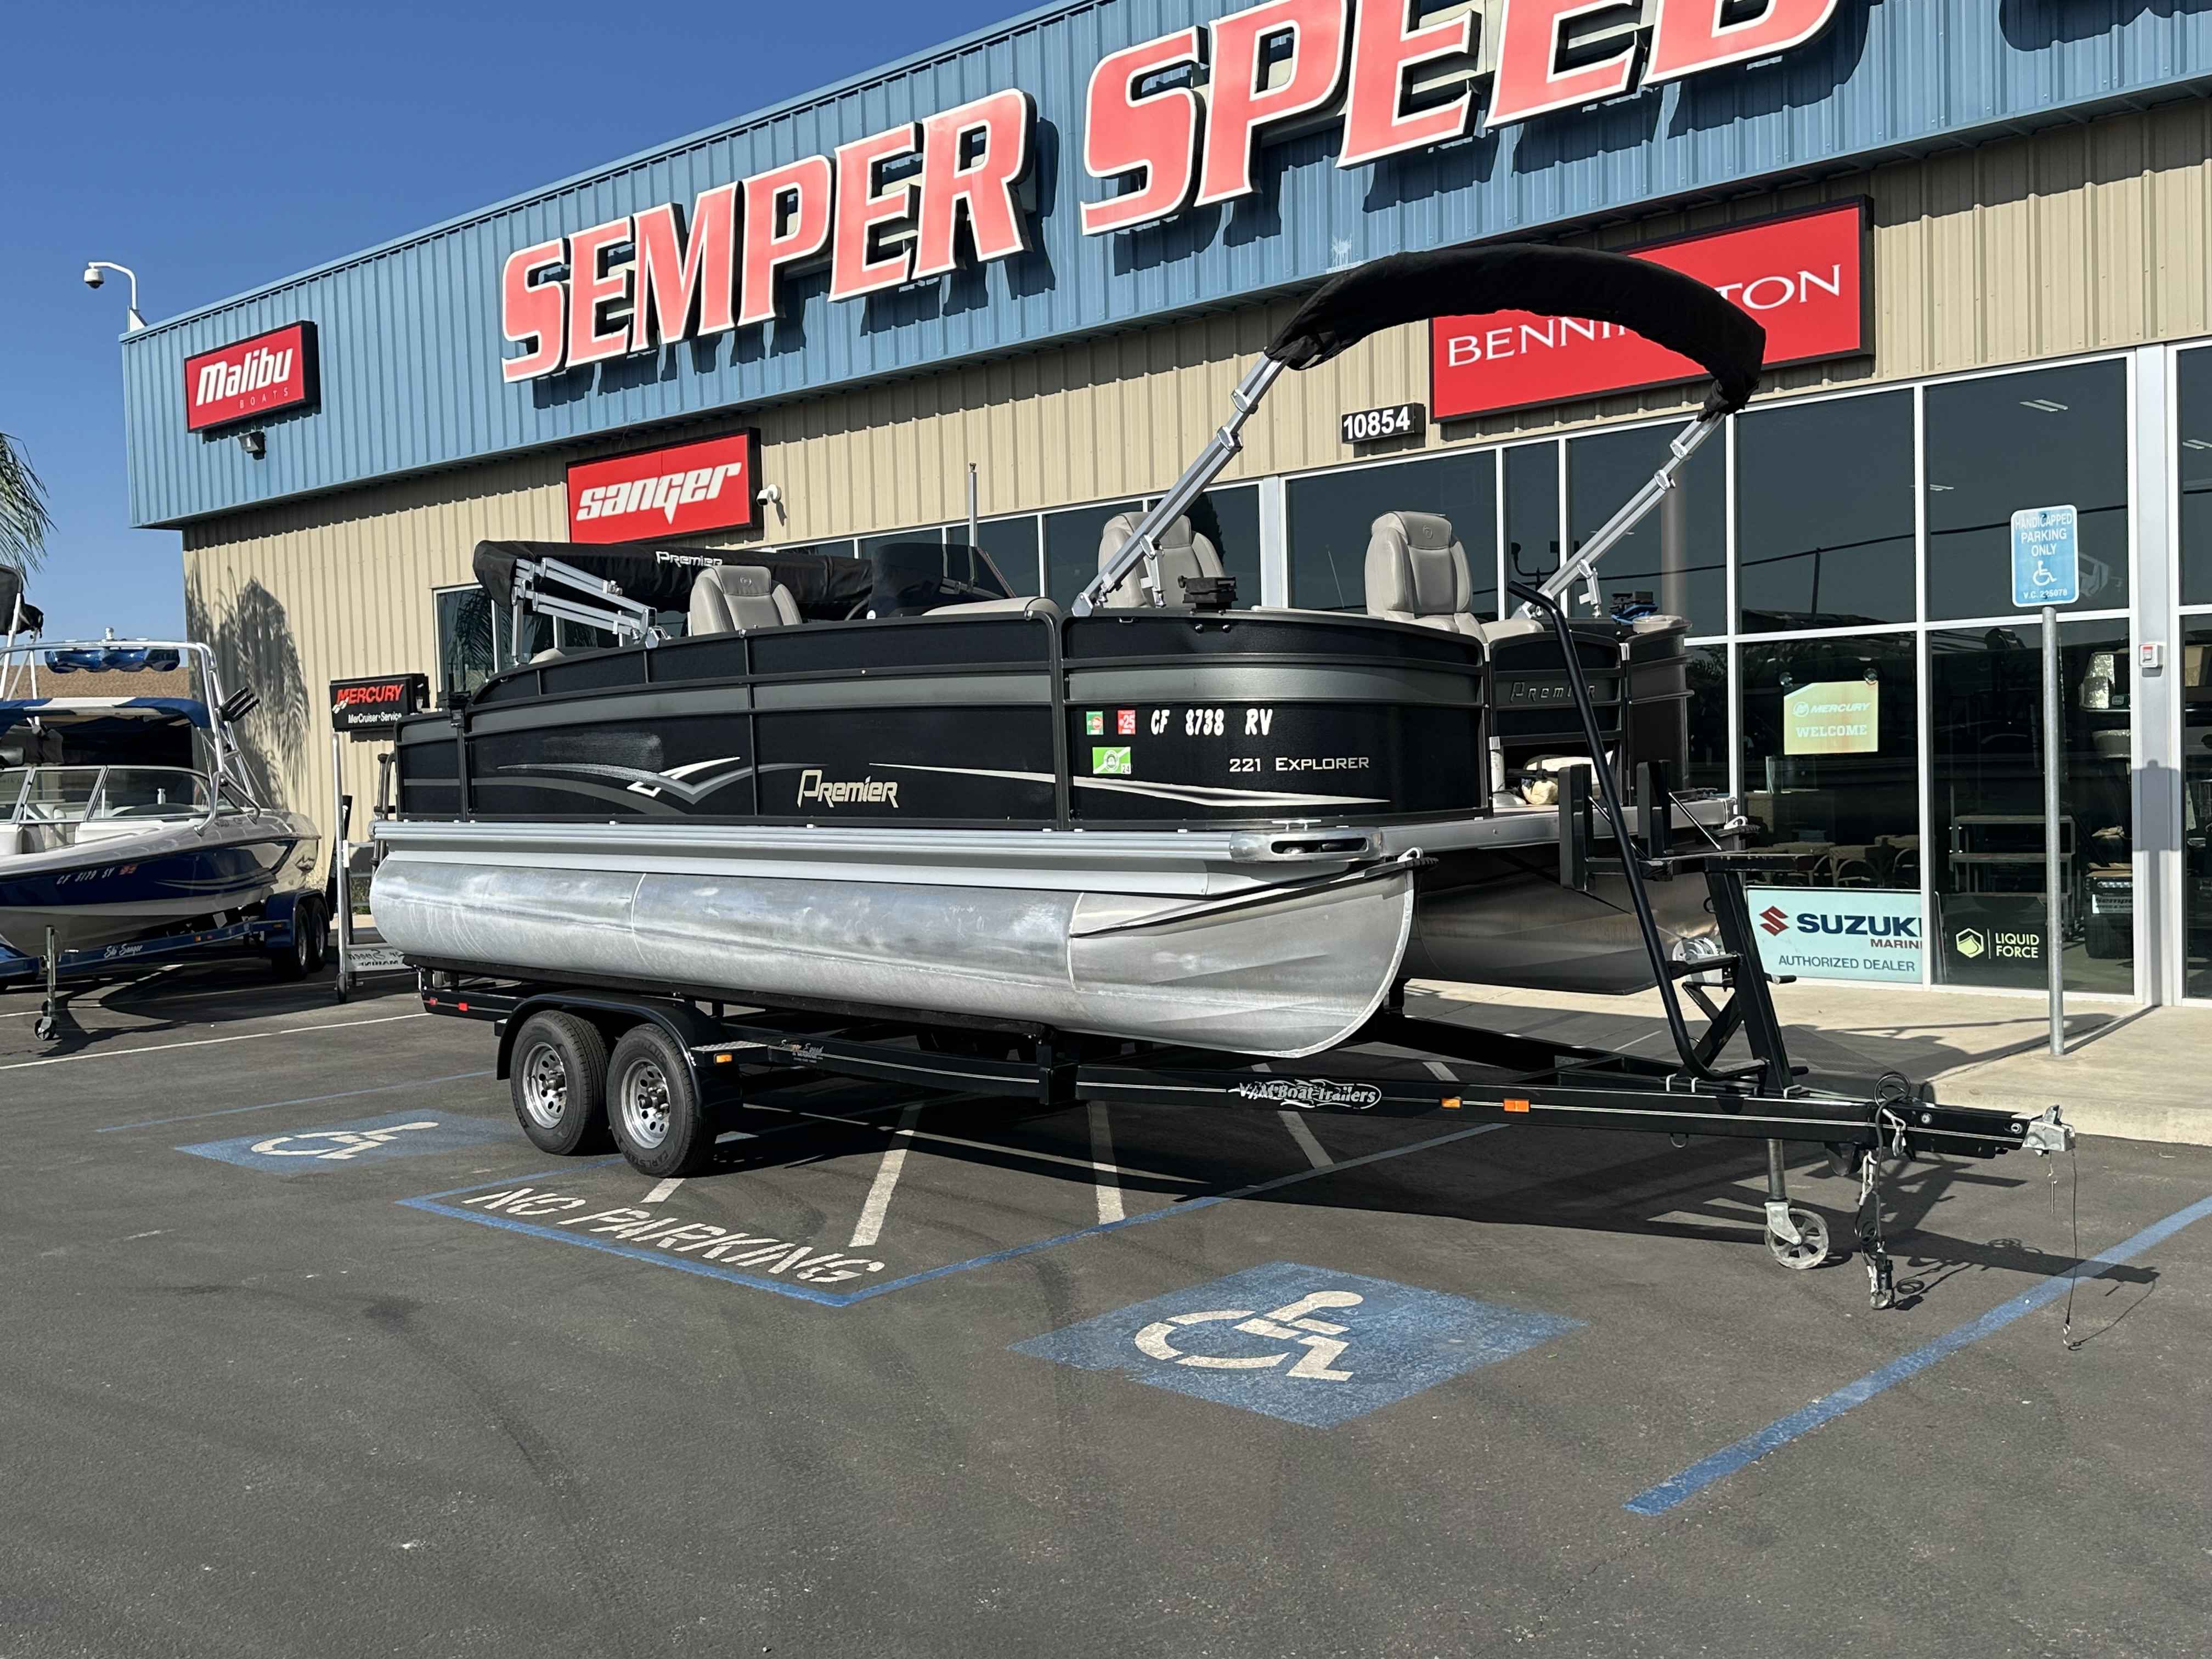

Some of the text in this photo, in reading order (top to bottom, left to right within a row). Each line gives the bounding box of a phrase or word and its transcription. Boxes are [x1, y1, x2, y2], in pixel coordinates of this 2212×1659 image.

[501, 88, 1025, 382] SEMPER
[196, 347, 293, 407] Malibu
[239, 387, 288, 408] BOATS
[1344, 406, 1410, 439] 10854
[2015, 514, 2072, 530] HANDICAPPED
[2021, 528, 2067, 544] PARKING
[2032, 543, 2057, 556] ONLY
[336, 684, 404, 705] MERCURY
[1810, 702, 1871, 713] MERCURY
[1151, 709, 1273, 736] CF 8738 RV
[1796, 724, 1867, 737] WELCOME
[1229, 758, 1261, 772] 221
[57, 874, 71, 885] CF
[1870, 939, 1922, 949] MARIN
[1995, 933, 2039, 945] LIQUID
[1996, 945, 2039, 958] FORCE
[1779, 955, 1915, 972] AUTHORIZED DEALER
[461, 1188, 885, 1283] NO PARKING
